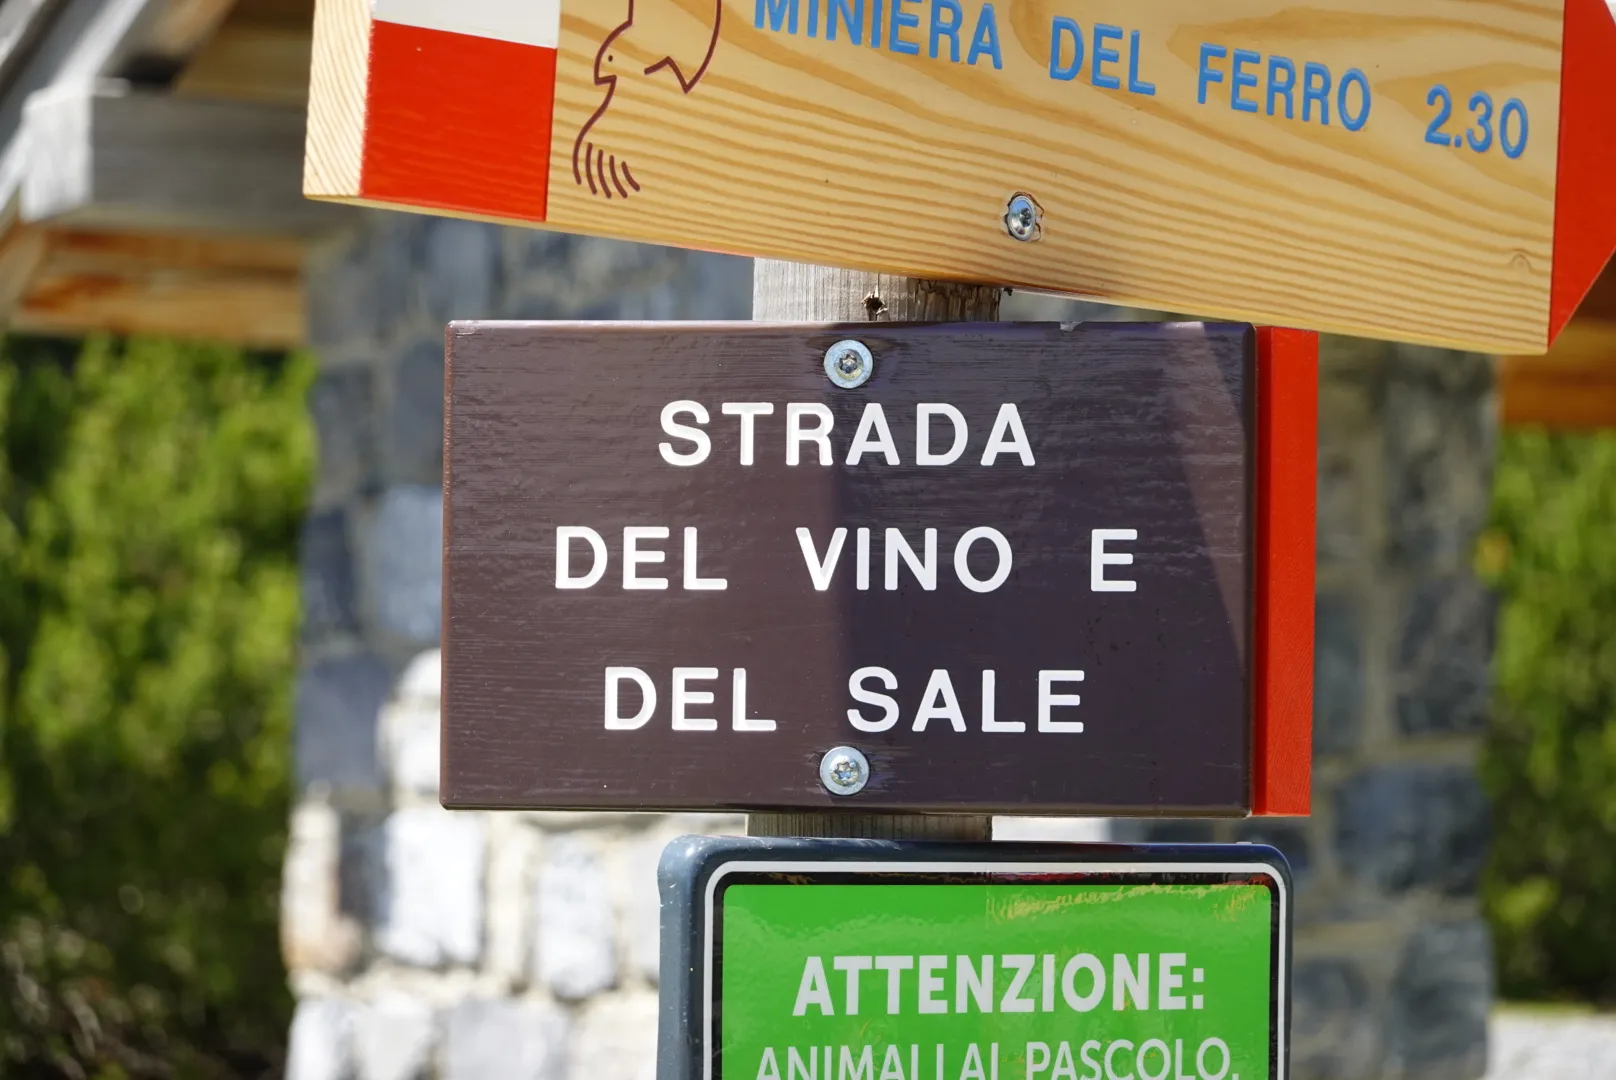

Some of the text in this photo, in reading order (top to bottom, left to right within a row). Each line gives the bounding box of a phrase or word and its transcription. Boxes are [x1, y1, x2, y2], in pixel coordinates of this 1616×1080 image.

[754, 0, 1528, 159] MINIERA DEL FERRO 2.30
[658, 399, 1036, 467] STRADA
[554, 525, 1139, 594] DEL VINO E
[604, 666, 1085, 734] DEL SALE
[792, 952, 1205, 1017] ATTENZIONE:
